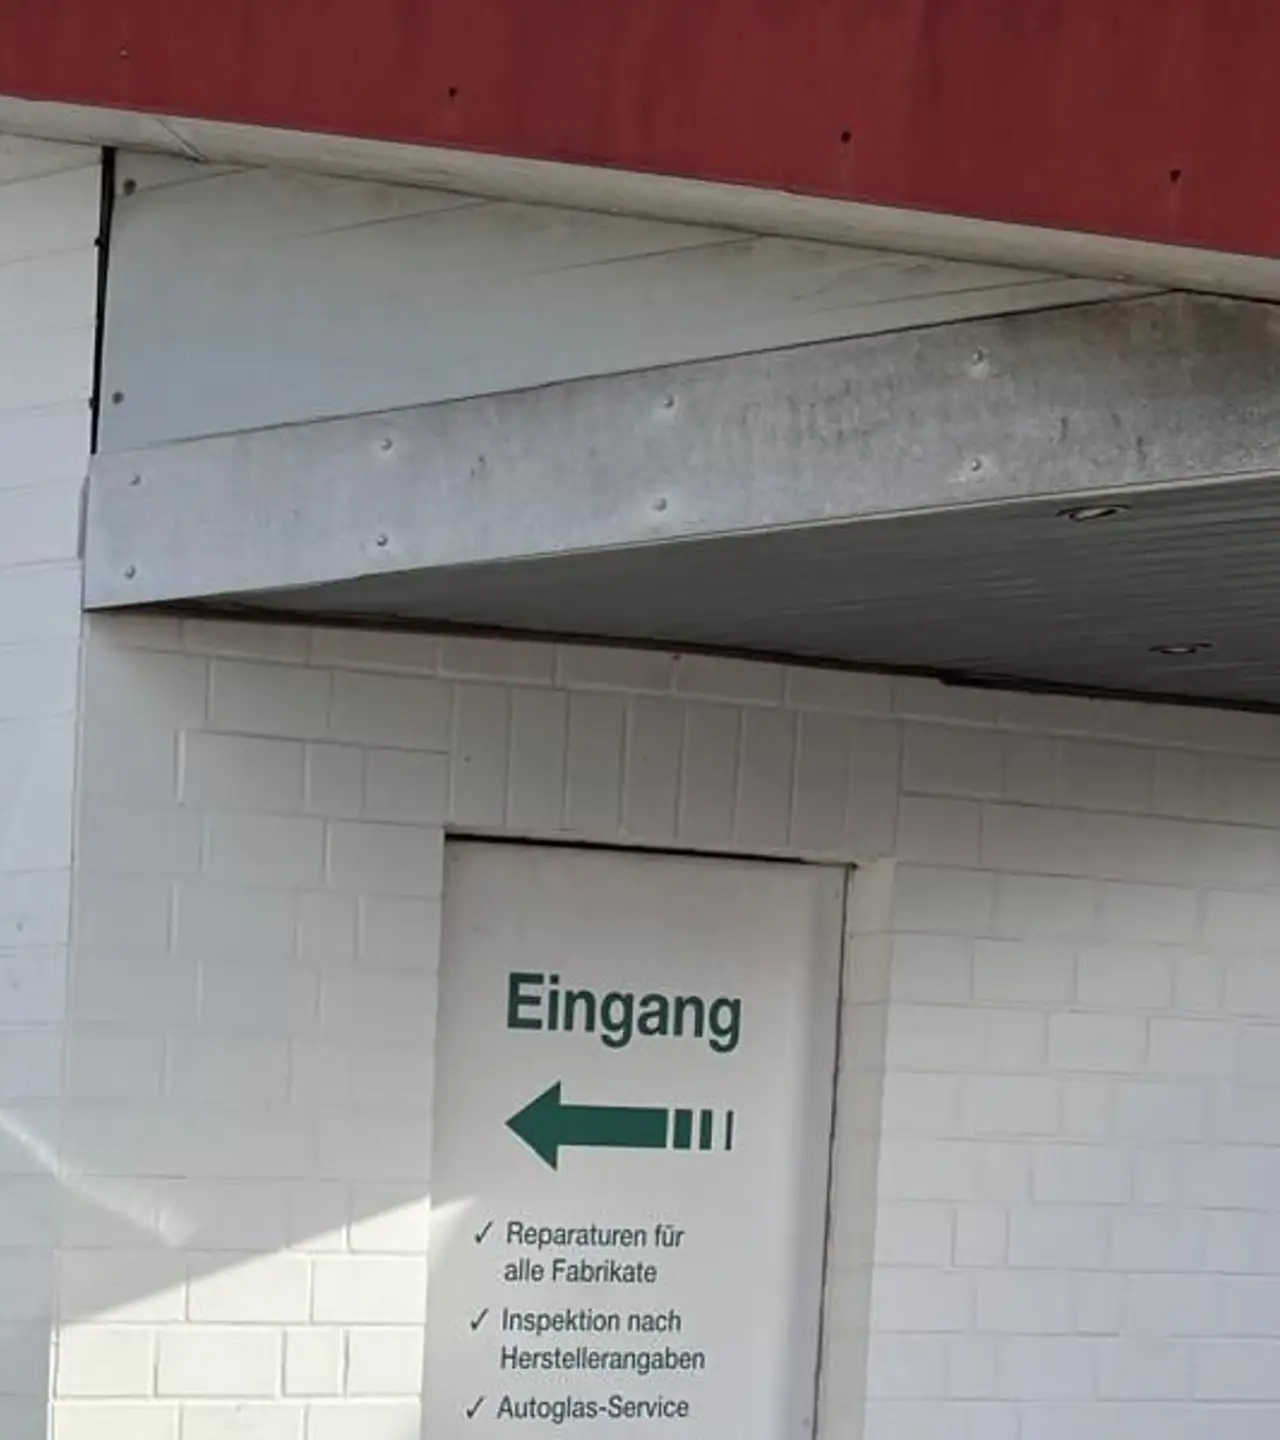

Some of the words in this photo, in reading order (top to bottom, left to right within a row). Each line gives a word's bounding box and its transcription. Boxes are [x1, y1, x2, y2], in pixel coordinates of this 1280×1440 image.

[507, 972, 741, 1052] Eingang
[507, 1221, 647, 1250] Reparaturen
[655, 1222, 685, 1248] für
[505, 1258, 544, 1281] alle
[552, 1258, 657, 1283] Fabrikate
[503, 1308, 620, 1335] Inspektion
[628, 1309, 681, 1332] nach
[501, 1346, 705, 1375] Herstellerangaben
[497, 1395, 689, 1424] Autoglas-Service
